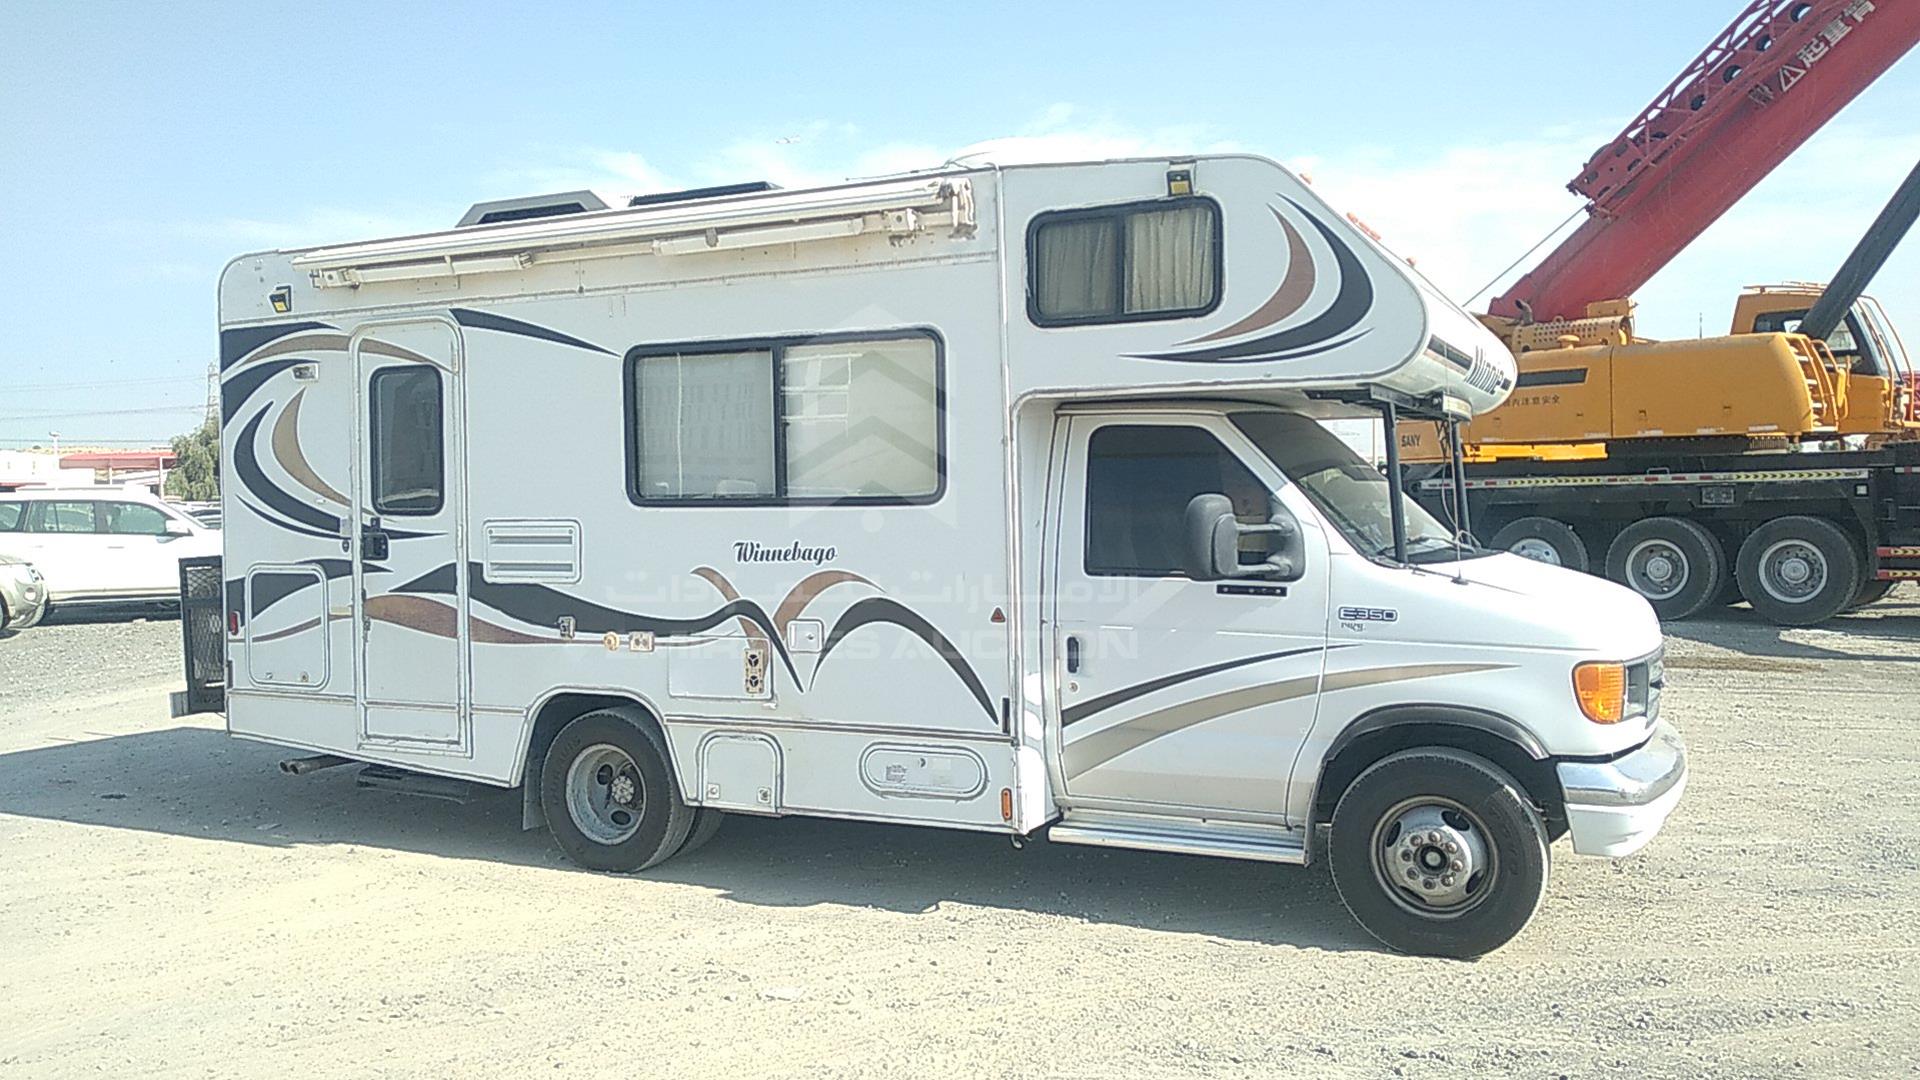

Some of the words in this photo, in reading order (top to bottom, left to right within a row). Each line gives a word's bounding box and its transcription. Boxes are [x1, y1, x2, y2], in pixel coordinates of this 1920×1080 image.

[1401, 434, 1420, 447] SANY
[733, 540, 837, 566] Winnebago
[1339, 606, 1398, 621] E350
